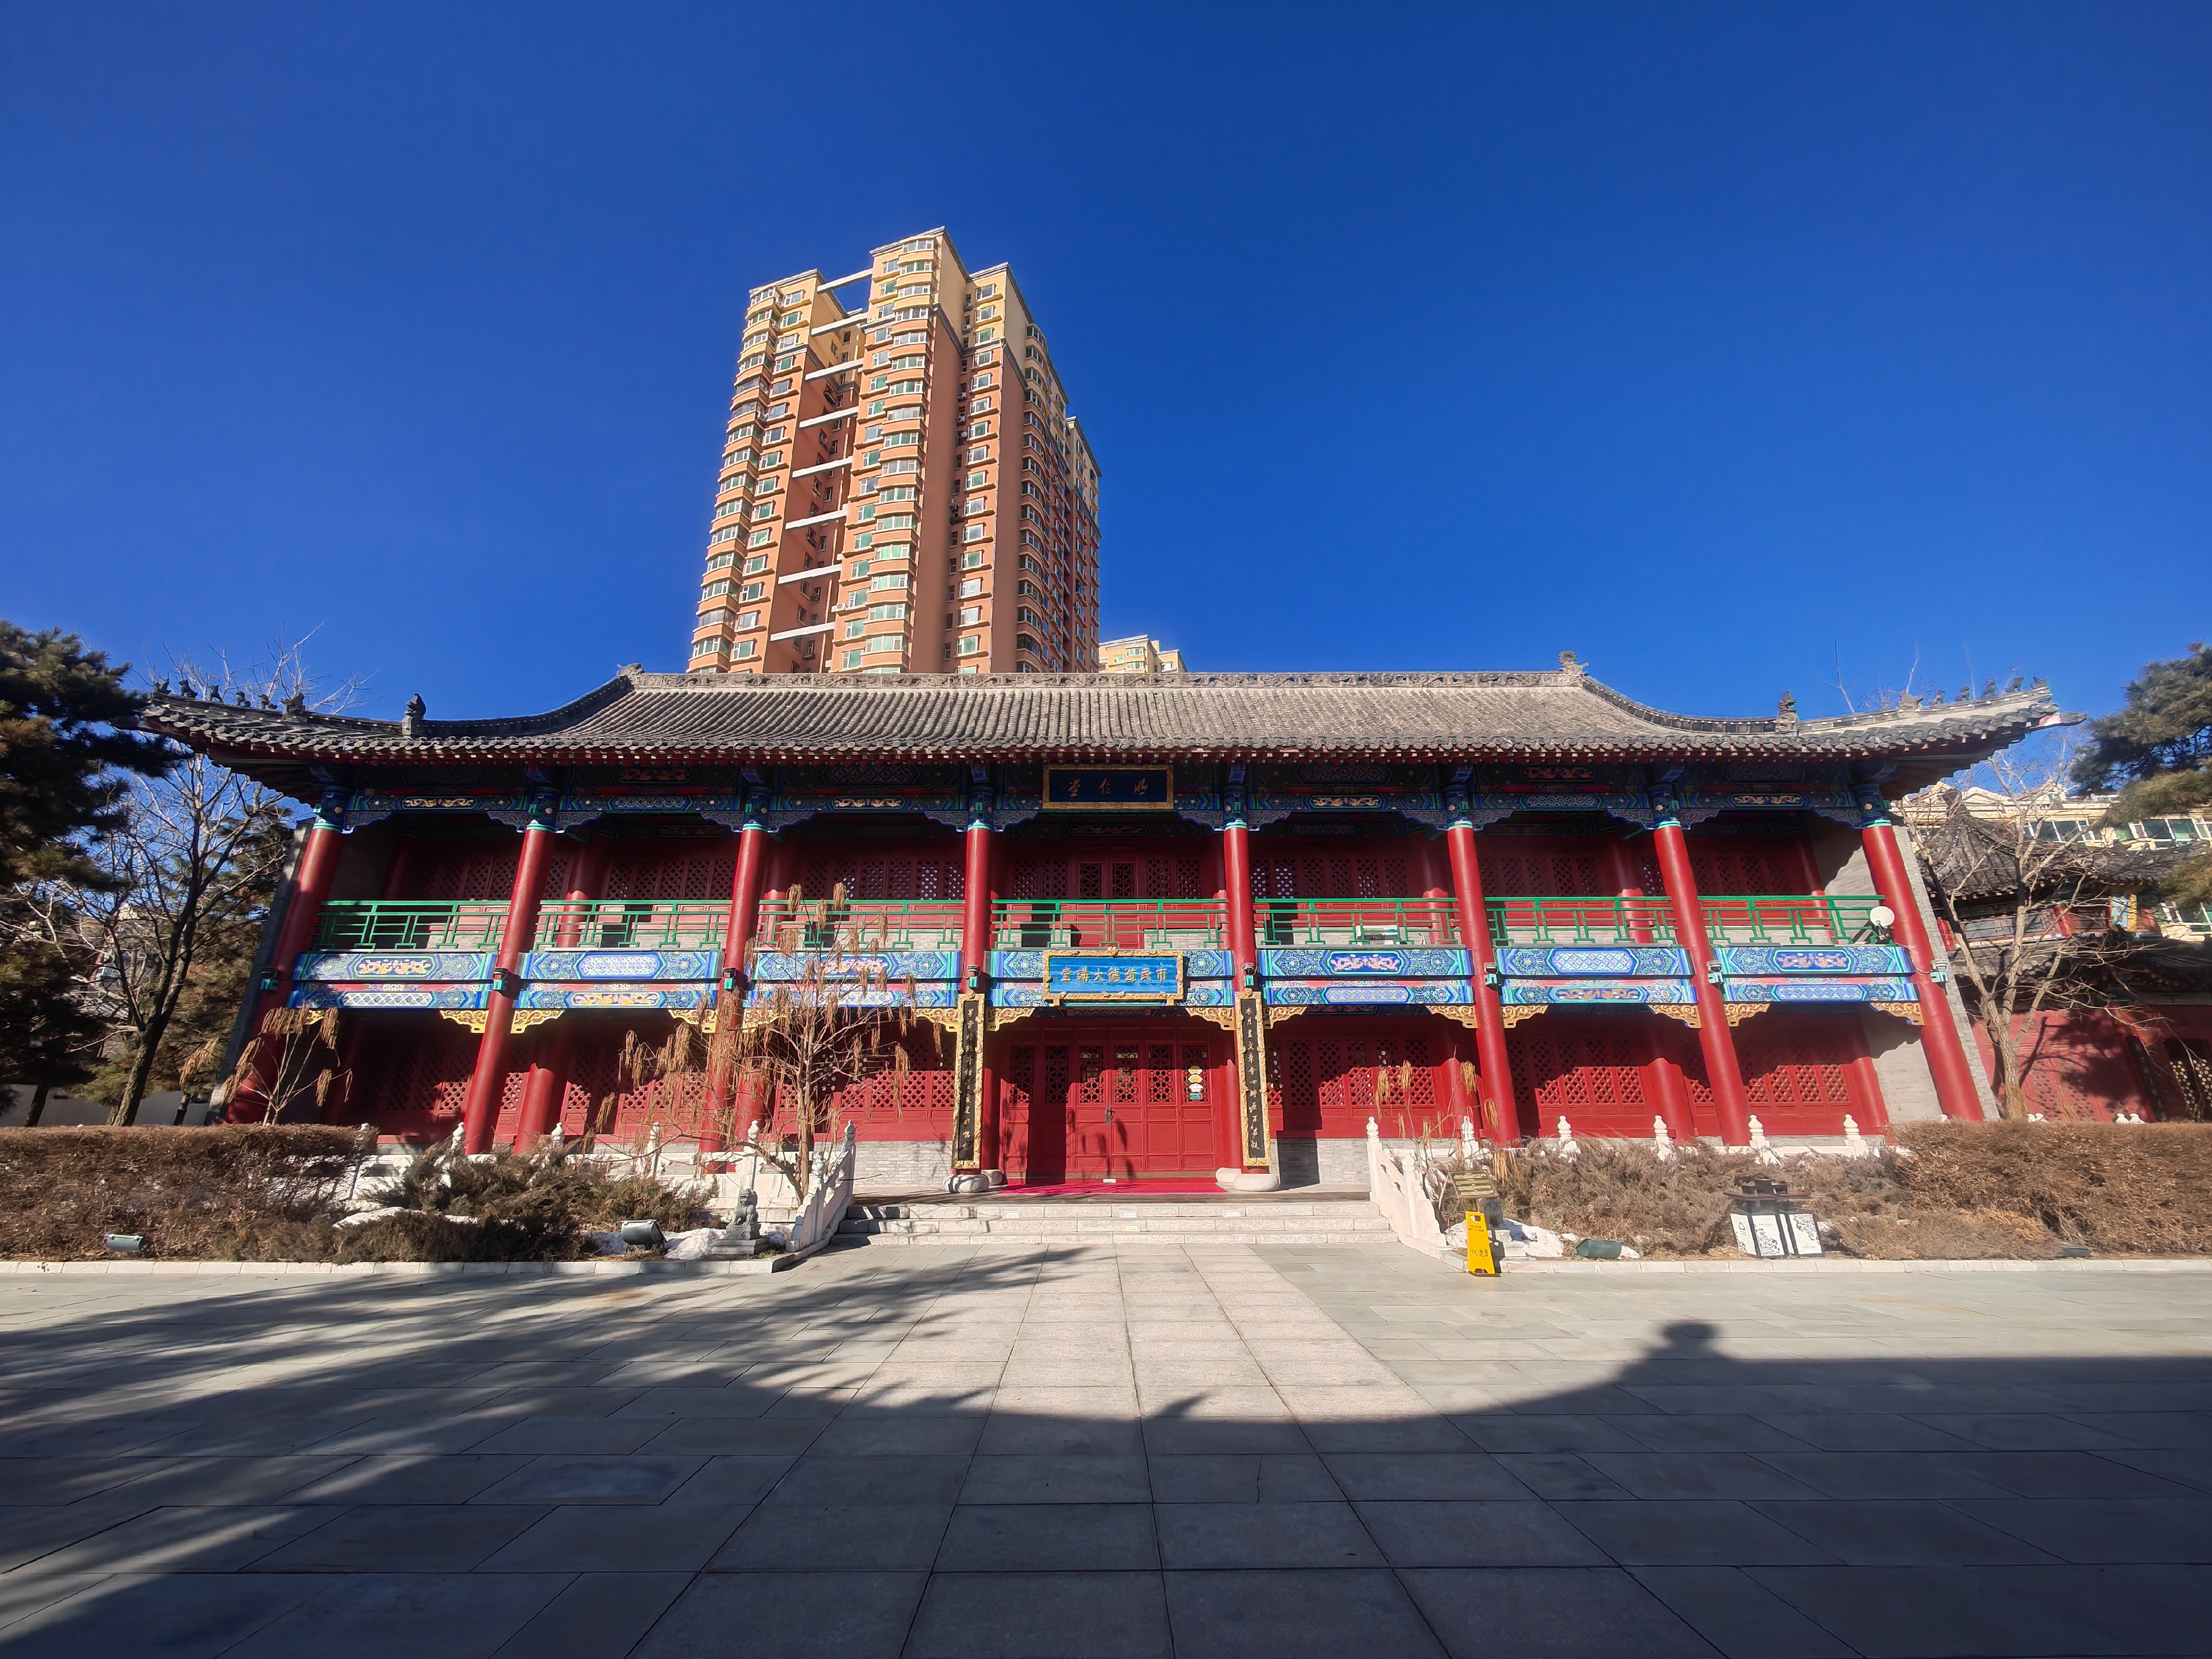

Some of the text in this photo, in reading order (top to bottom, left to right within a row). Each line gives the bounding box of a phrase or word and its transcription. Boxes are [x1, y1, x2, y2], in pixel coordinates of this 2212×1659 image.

[1060, 967, 1168, 983] 市民道德大講堂
